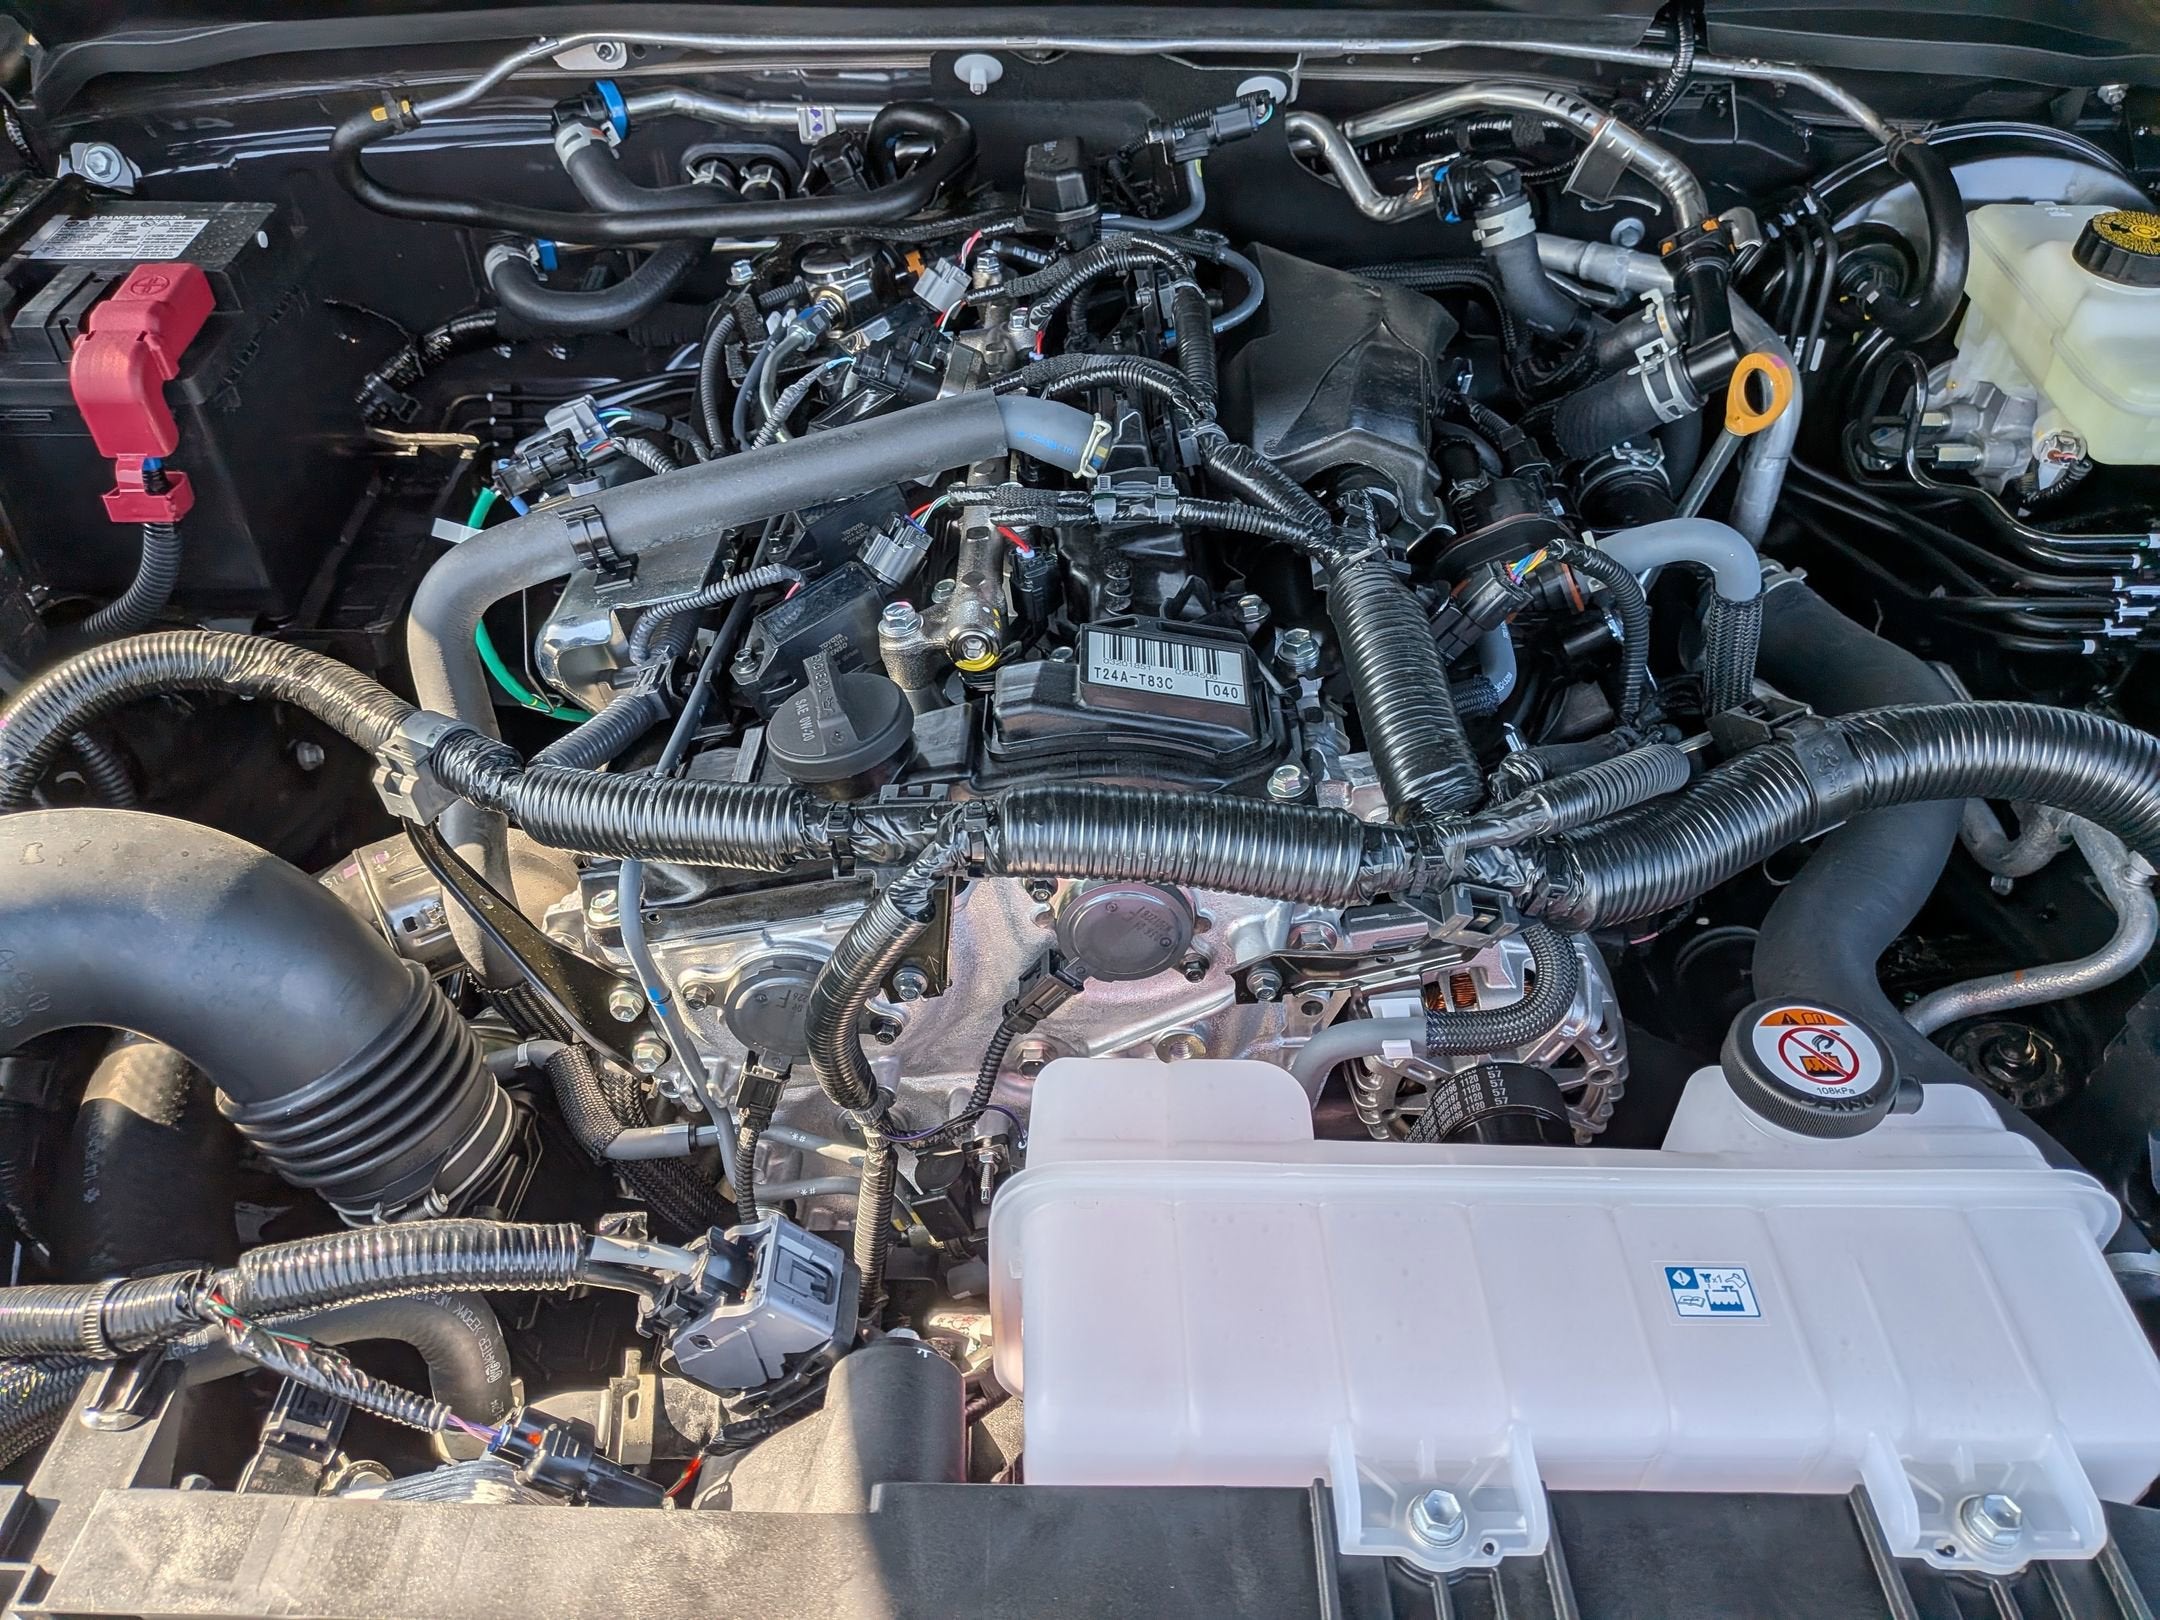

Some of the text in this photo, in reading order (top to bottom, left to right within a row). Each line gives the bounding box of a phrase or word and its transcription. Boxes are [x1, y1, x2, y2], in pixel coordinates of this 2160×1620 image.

[819, 633, 843, 649] TOYOTA
[1094, 667, 1174, 690] T24A-T83C
[1213, 684, 1239, 699] 040
[795, 698, 809, 716] SAE
[1459, 1074, 1480, 1088] 1120
[1487, 1070, 1502, 1079] 57
[1461, 1082, 1481, 1097] 1120
[1489, 1079, 1504, 1088] 57
[1463, 1091, 1483, 1106] 1120
[1491, 1087, 1506, 1097] 57
[1816, 1086, 1856, 1095] 108kPa
[1466, 1100, 1486, 1114] 1120
[1494, 1096, 1509, 1106] 57
[1800, 1093, 1876, 1112] DENSO
